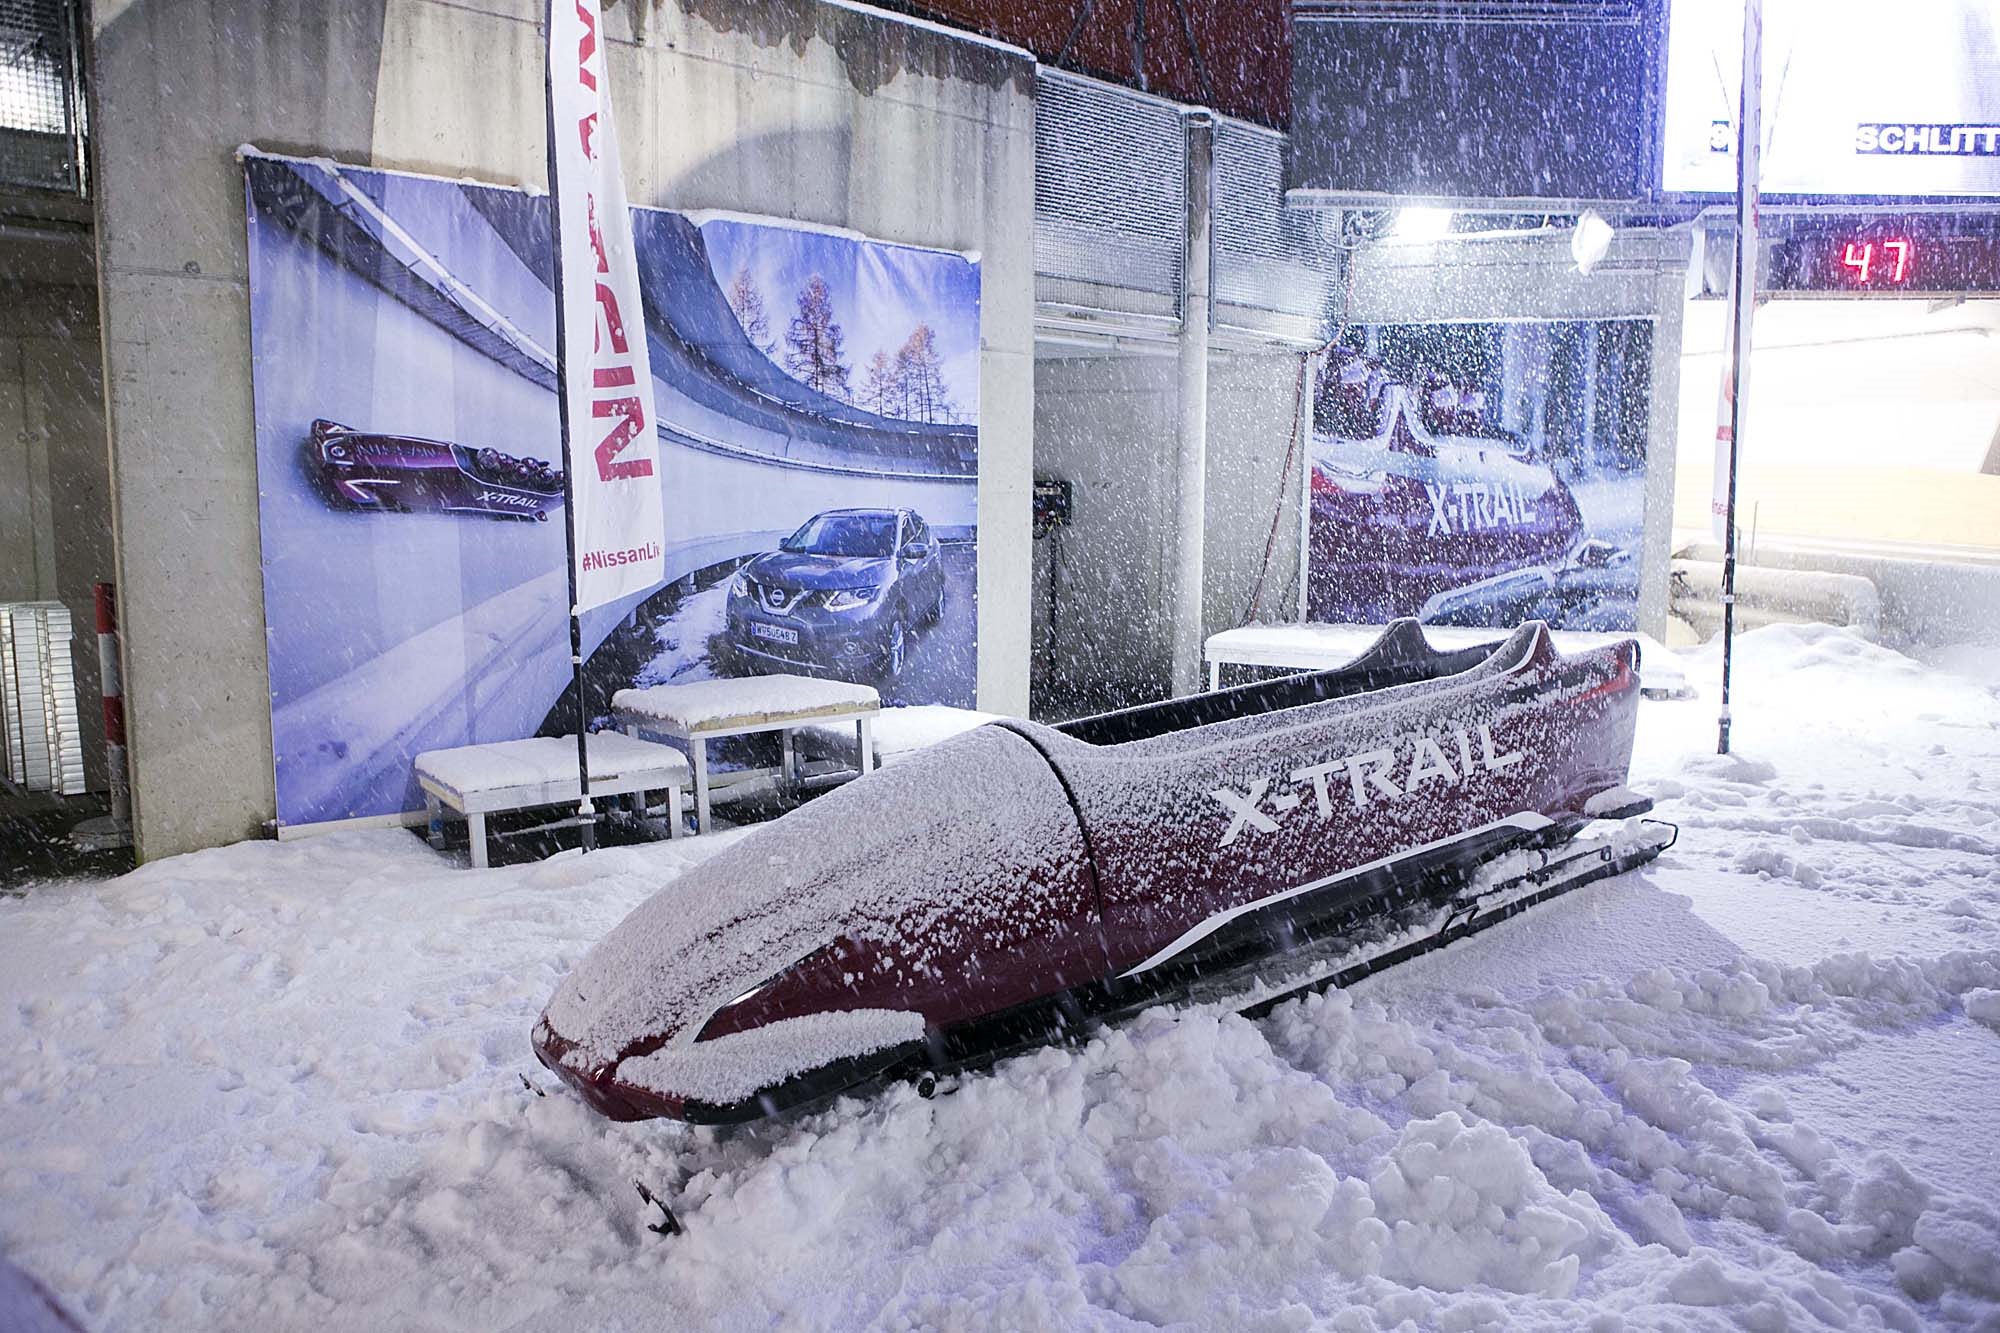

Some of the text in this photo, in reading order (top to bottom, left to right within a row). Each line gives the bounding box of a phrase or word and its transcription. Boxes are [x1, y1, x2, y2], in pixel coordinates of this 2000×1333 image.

[1844, 241, 1907, 282] 47
[476, 490, 538, 508] X-TRAIL
[1423, 481, 1537, 538] X-TRAIL
[1211, 724, 1523, 848] X-TRAIL
